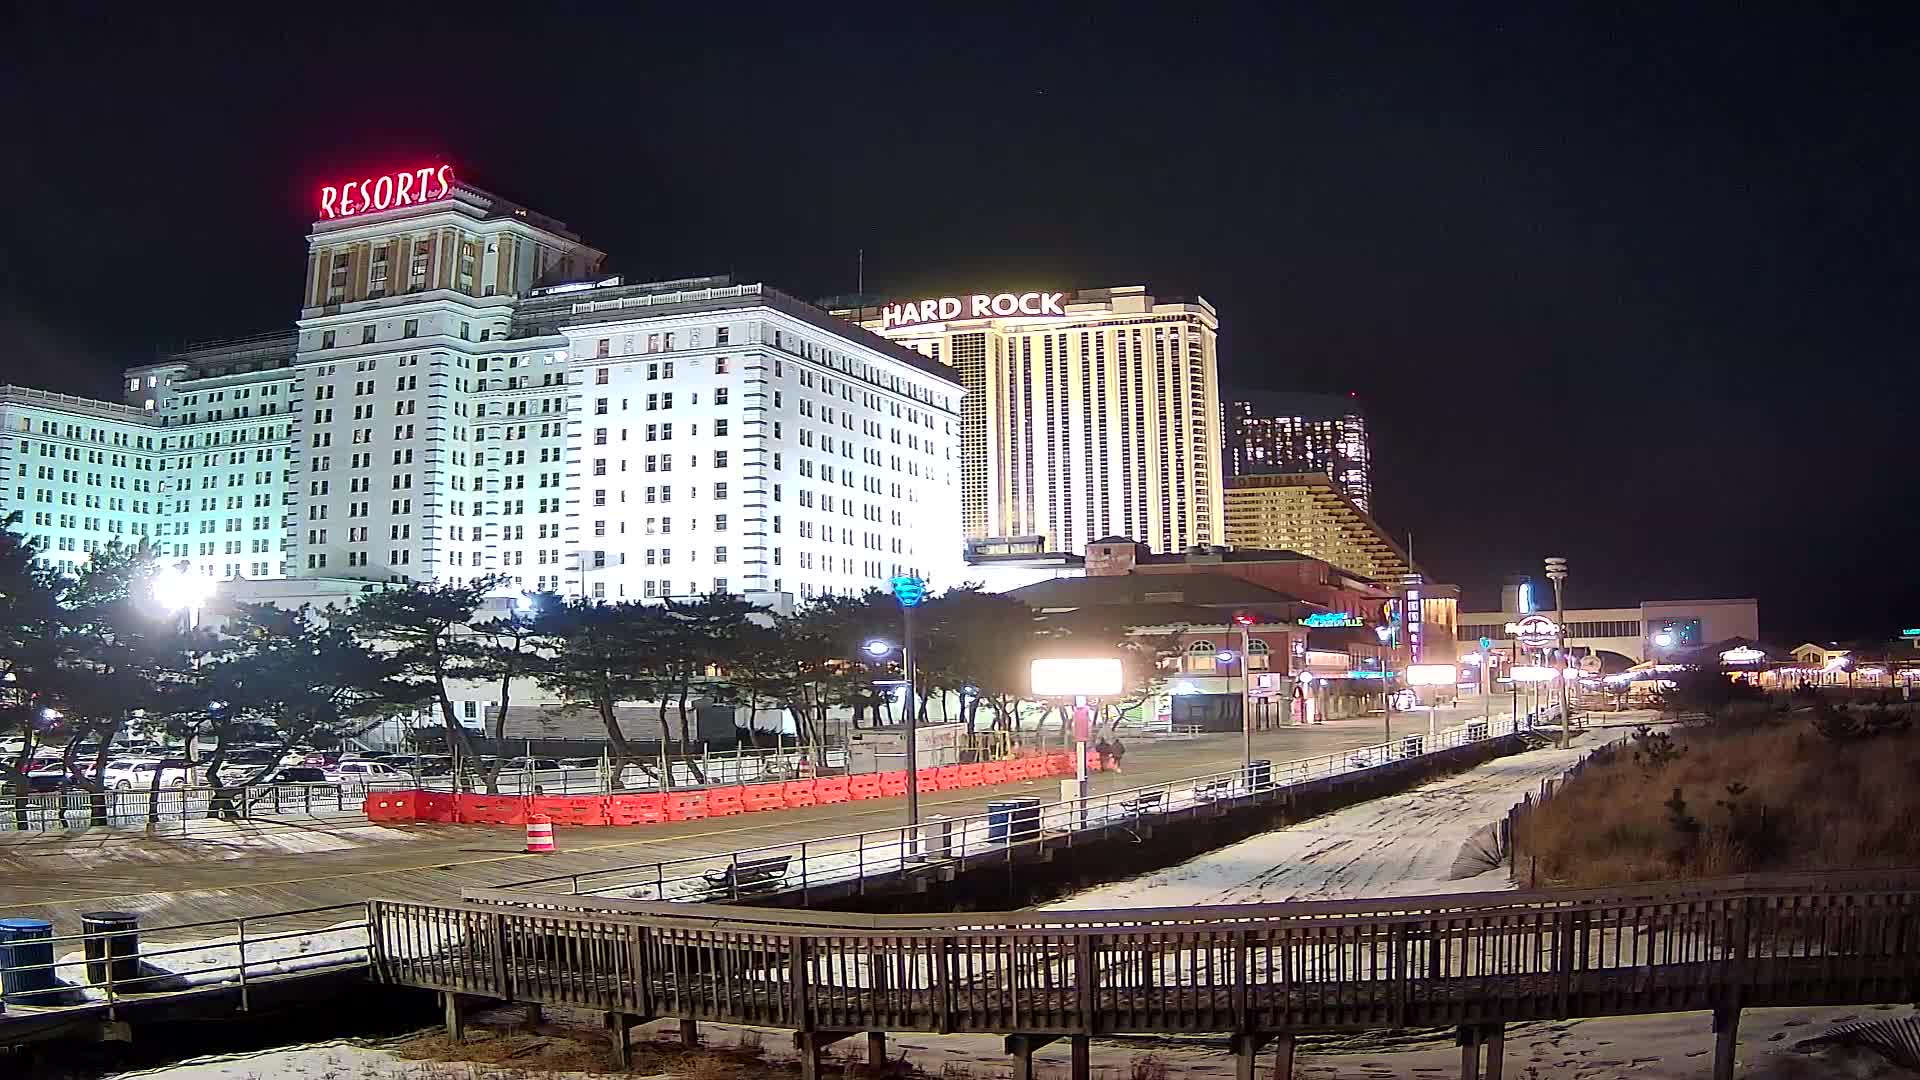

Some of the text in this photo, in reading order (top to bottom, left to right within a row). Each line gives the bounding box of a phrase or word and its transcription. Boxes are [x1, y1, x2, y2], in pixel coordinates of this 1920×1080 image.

[321, 165, 450, 219] RESORTS
[882, 293, 1063, 328] HARD ROCK
